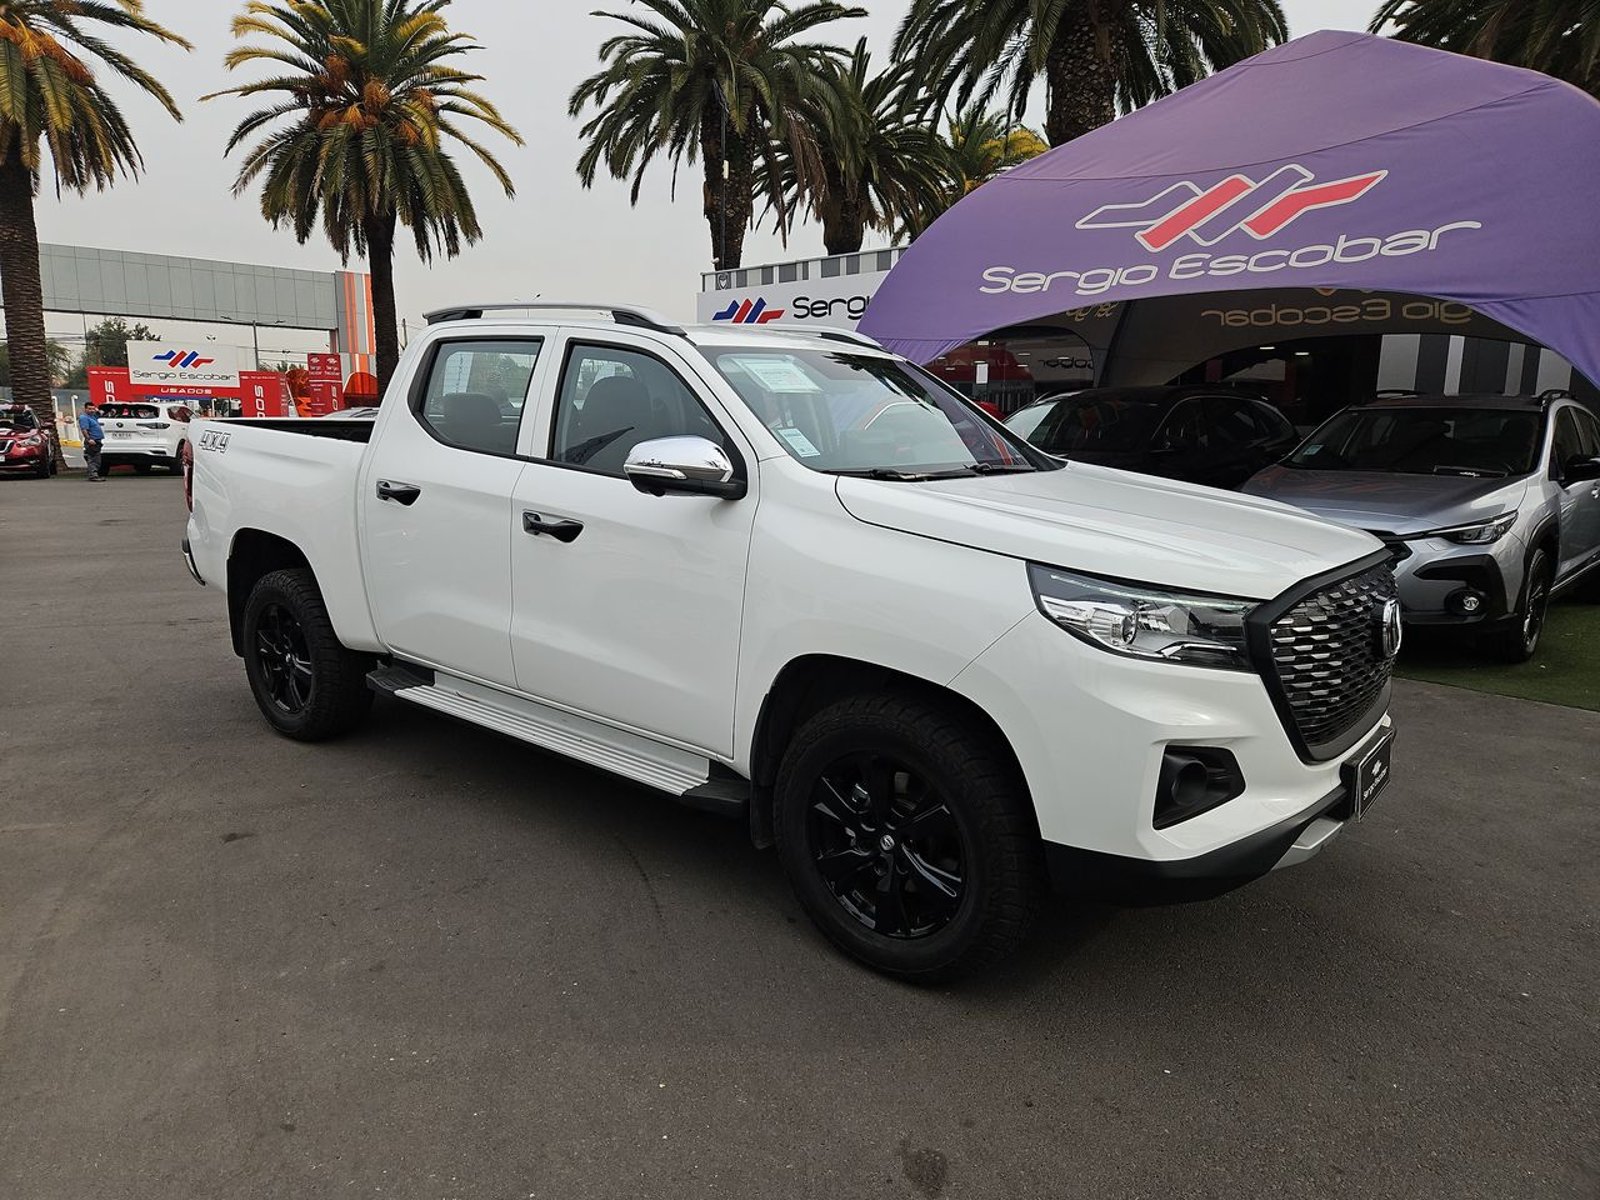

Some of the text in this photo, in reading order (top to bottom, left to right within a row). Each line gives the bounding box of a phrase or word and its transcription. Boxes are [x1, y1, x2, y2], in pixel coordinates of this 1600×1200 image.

[979, 220, 1482, 296] Sergio Escobar
[132, 369, 177, 381] Sergio
[179, 371, 237, 382] Escobar
[160, 387, 212, 395] USADOS
